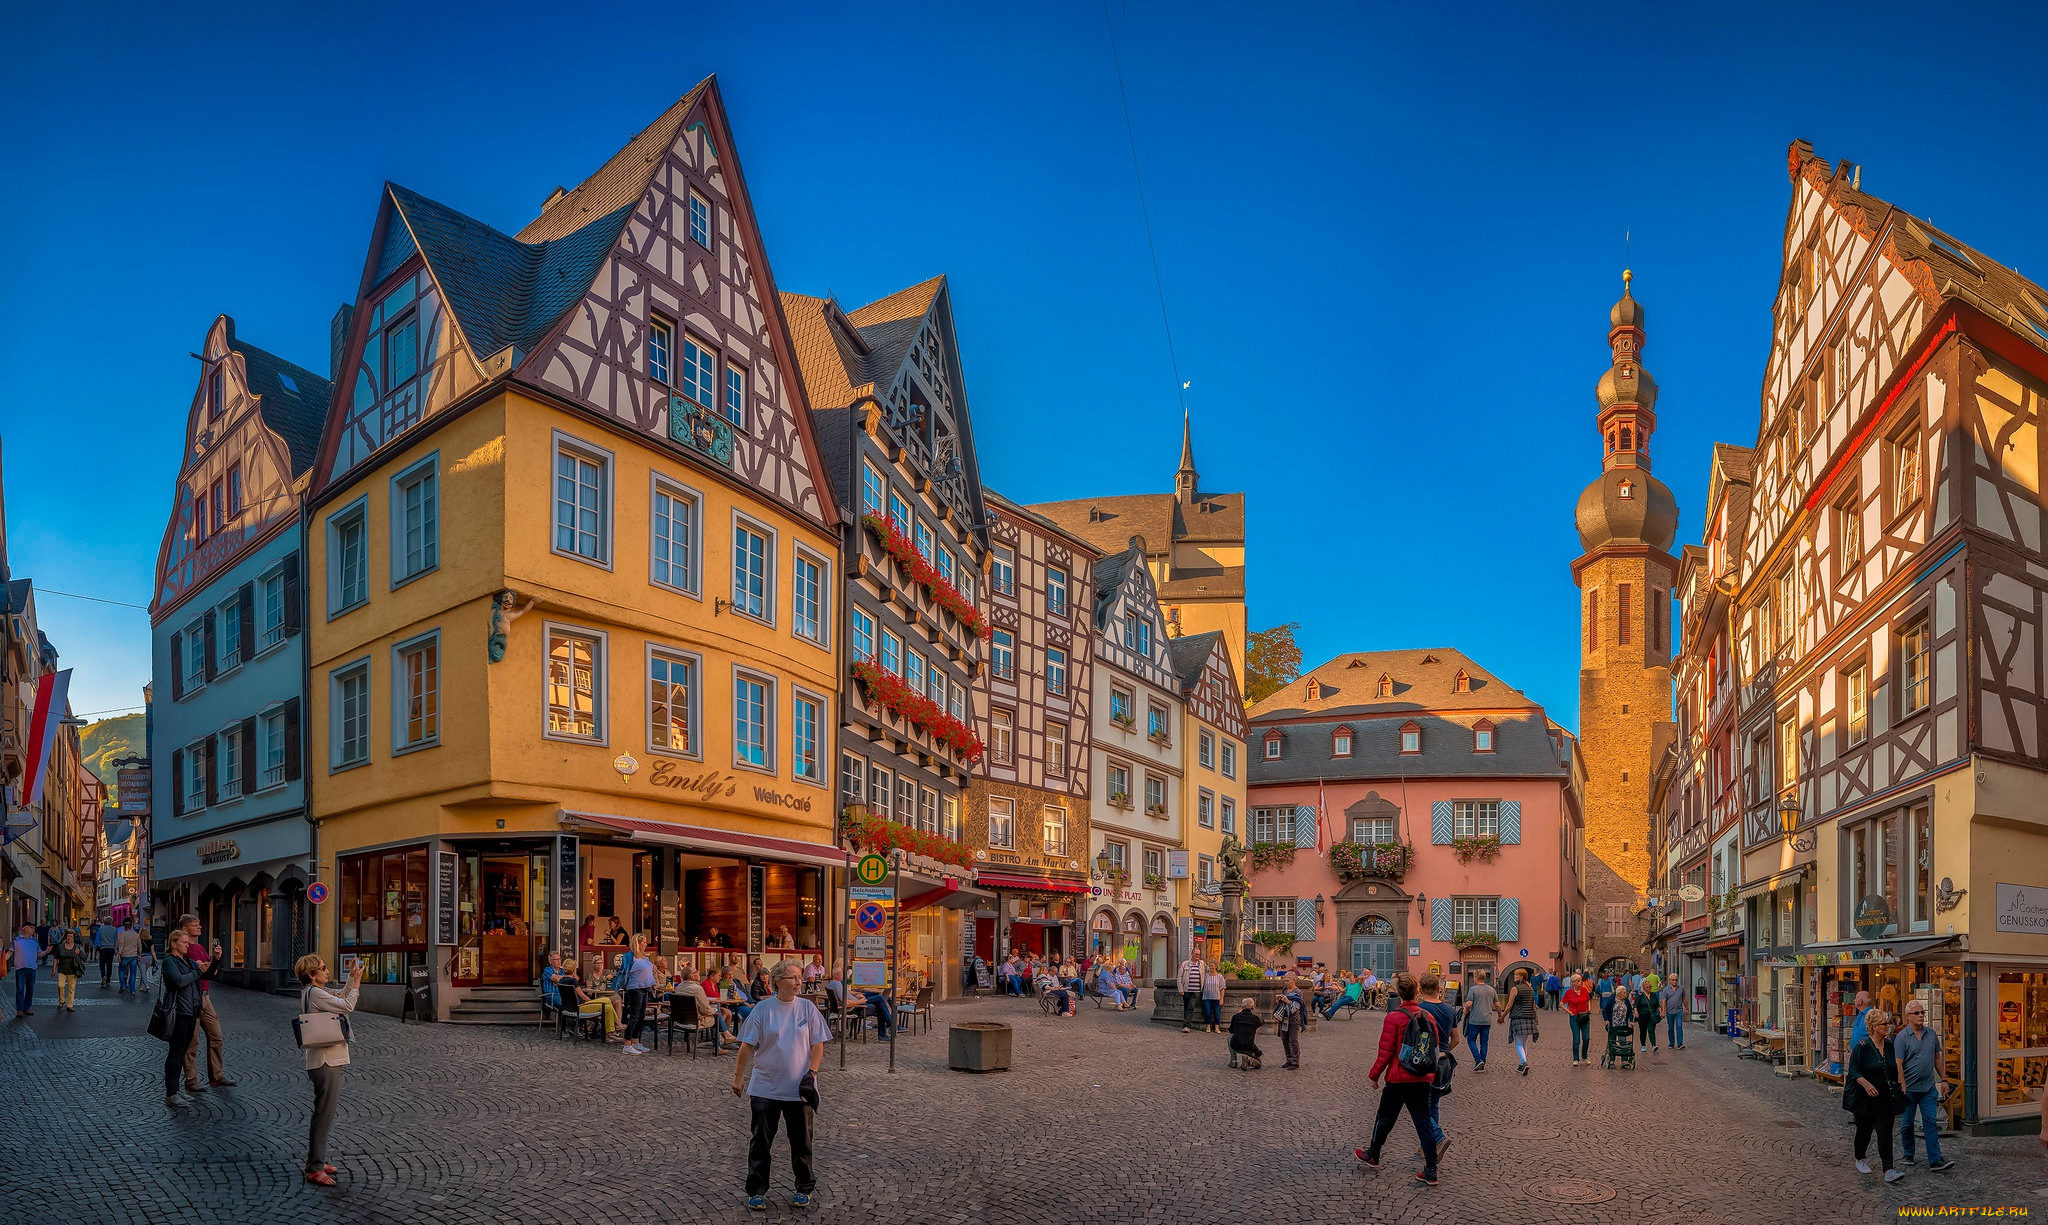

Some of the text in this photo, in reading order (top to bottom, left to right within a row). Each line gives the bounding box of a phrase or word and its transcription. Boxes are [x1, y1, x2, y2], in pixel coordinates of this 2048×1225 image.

[753, 785, 812, 813] Wein-Café
[990, 853, 1067, 869] BISTRO Am Markt
[866, 861, 879, 878] H
[1103, 888, 1142, 901] UNSR PLATZ
